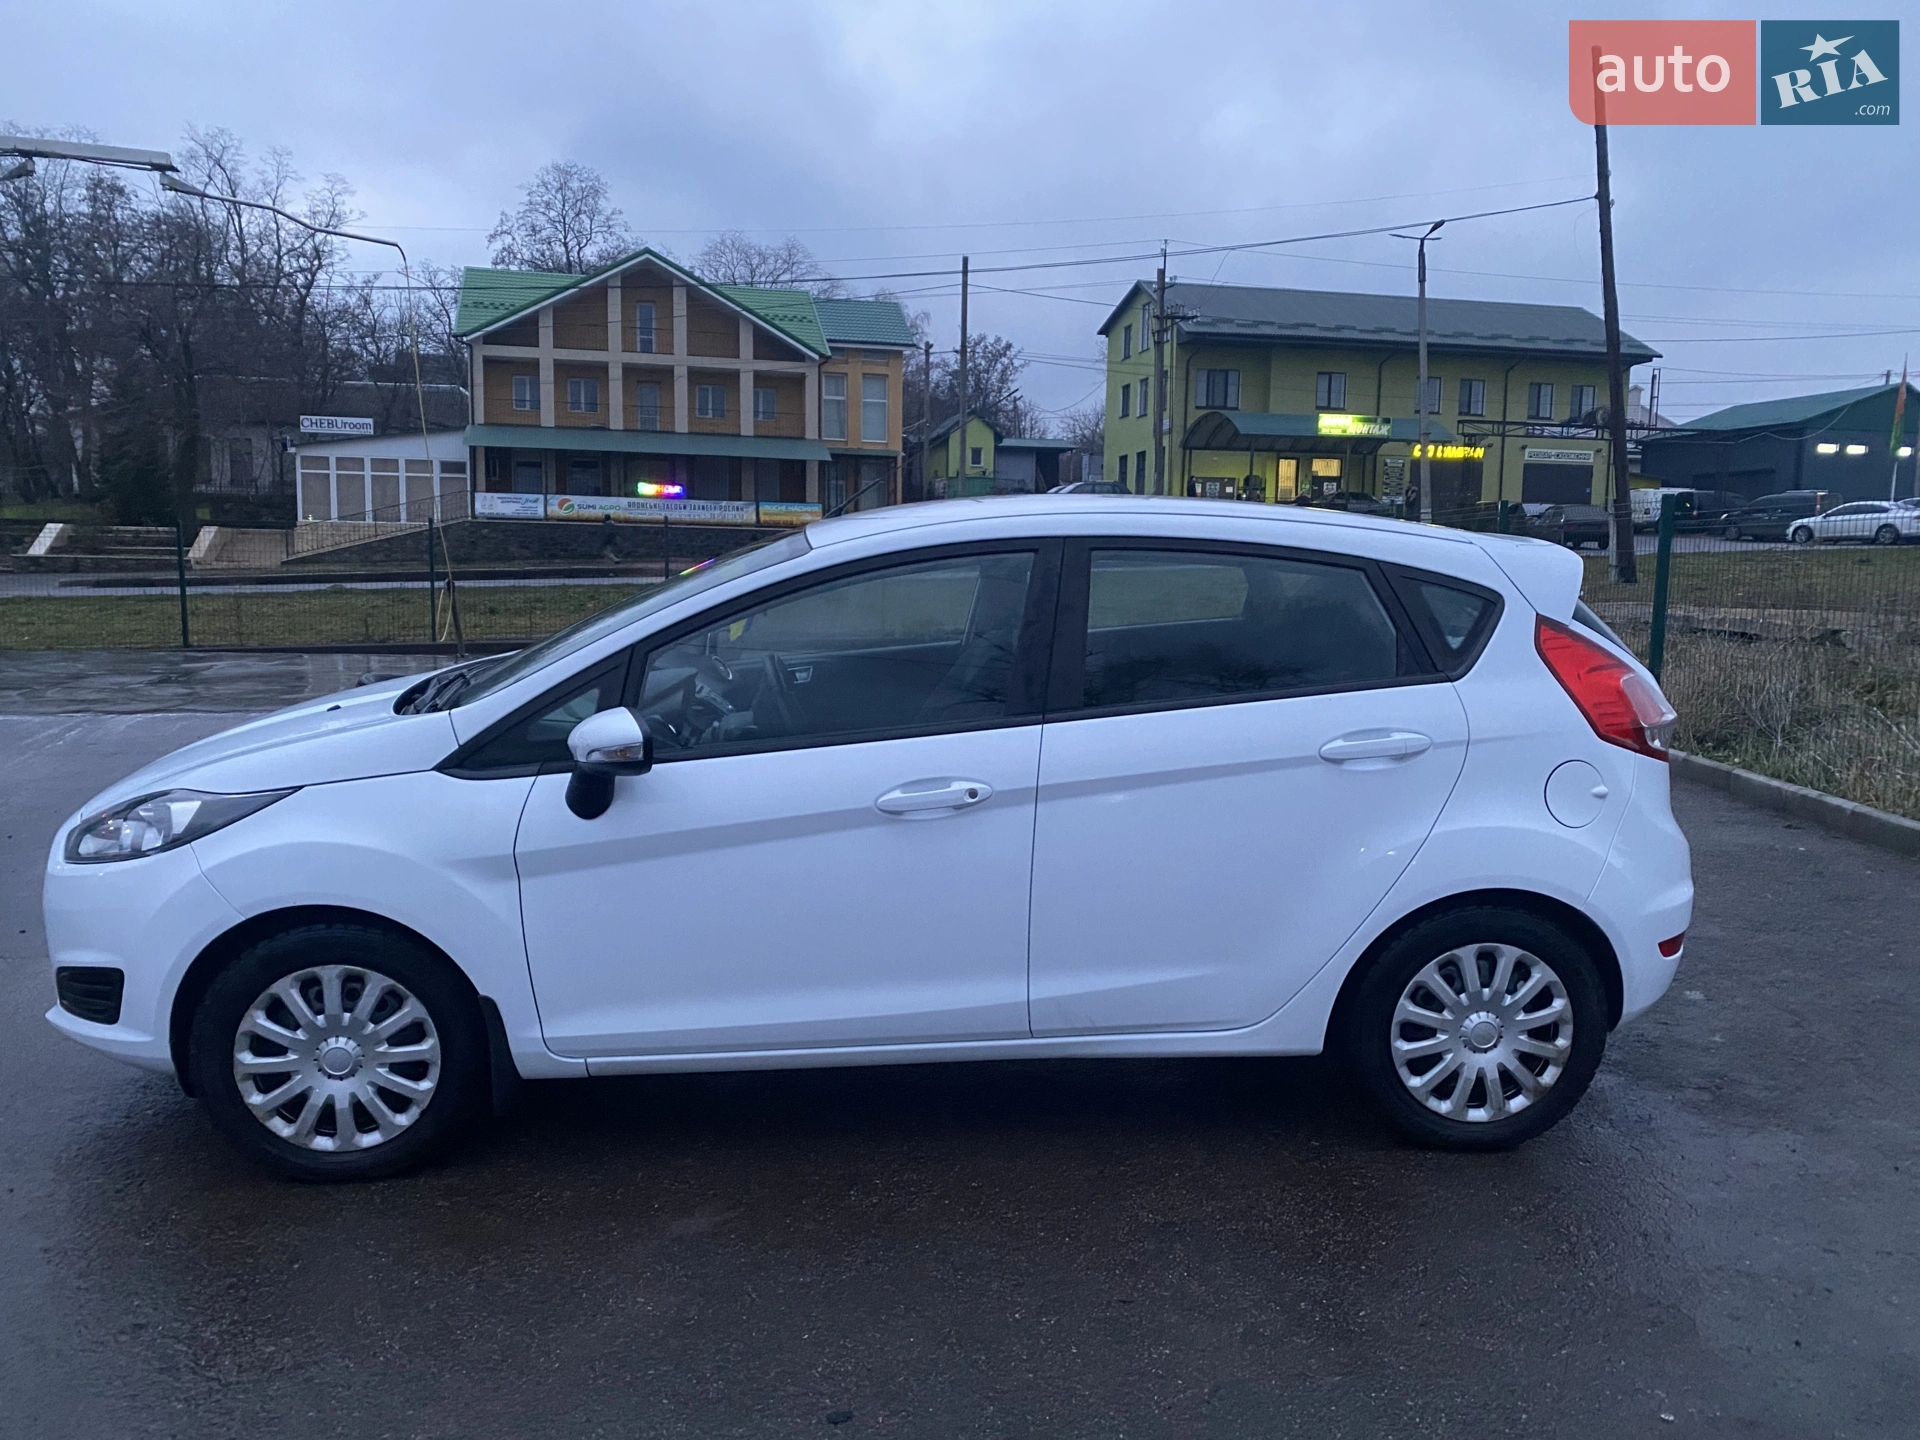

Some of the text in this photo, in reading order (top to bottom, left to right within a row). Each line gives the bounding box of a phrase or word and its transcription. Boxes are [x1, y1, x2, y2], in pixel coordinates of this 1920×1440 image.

[300, 417, 372, 430] CHEBUroom
[576, 503, 597, 511] SUMI
[627, 501, 660, 510] ЯПОНСЬКІ
[662, 502, 687, 511] ЗАСОБИ
